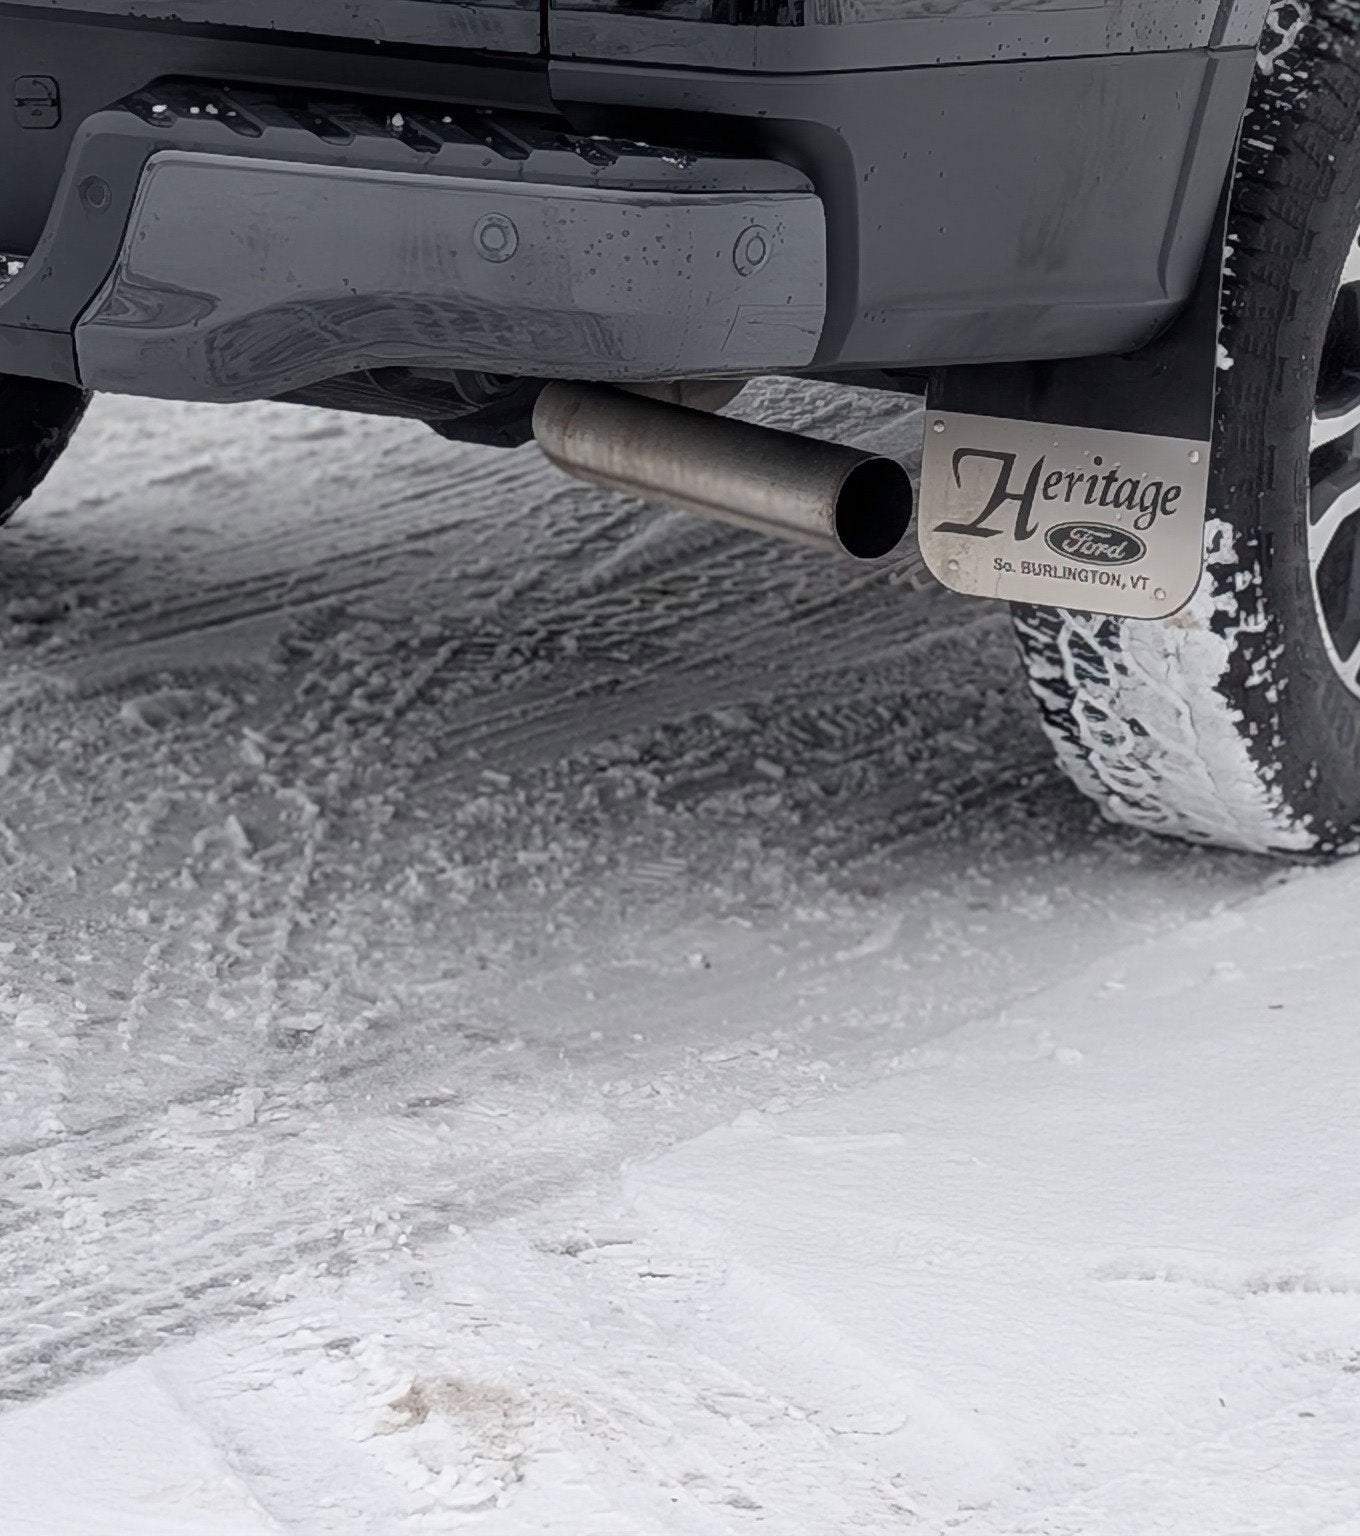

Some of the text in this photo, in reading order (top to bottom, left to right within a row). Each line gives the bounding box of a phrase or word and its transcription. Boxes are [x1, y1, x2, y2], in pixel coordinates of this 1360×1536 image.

[932, 446, 1183, 542] Heritage
[1061, 527, 1126, 560] Ford
[1020, 560, 1127, 591] BURLINGTON,
[1130, 574, 1151, 591] VT
